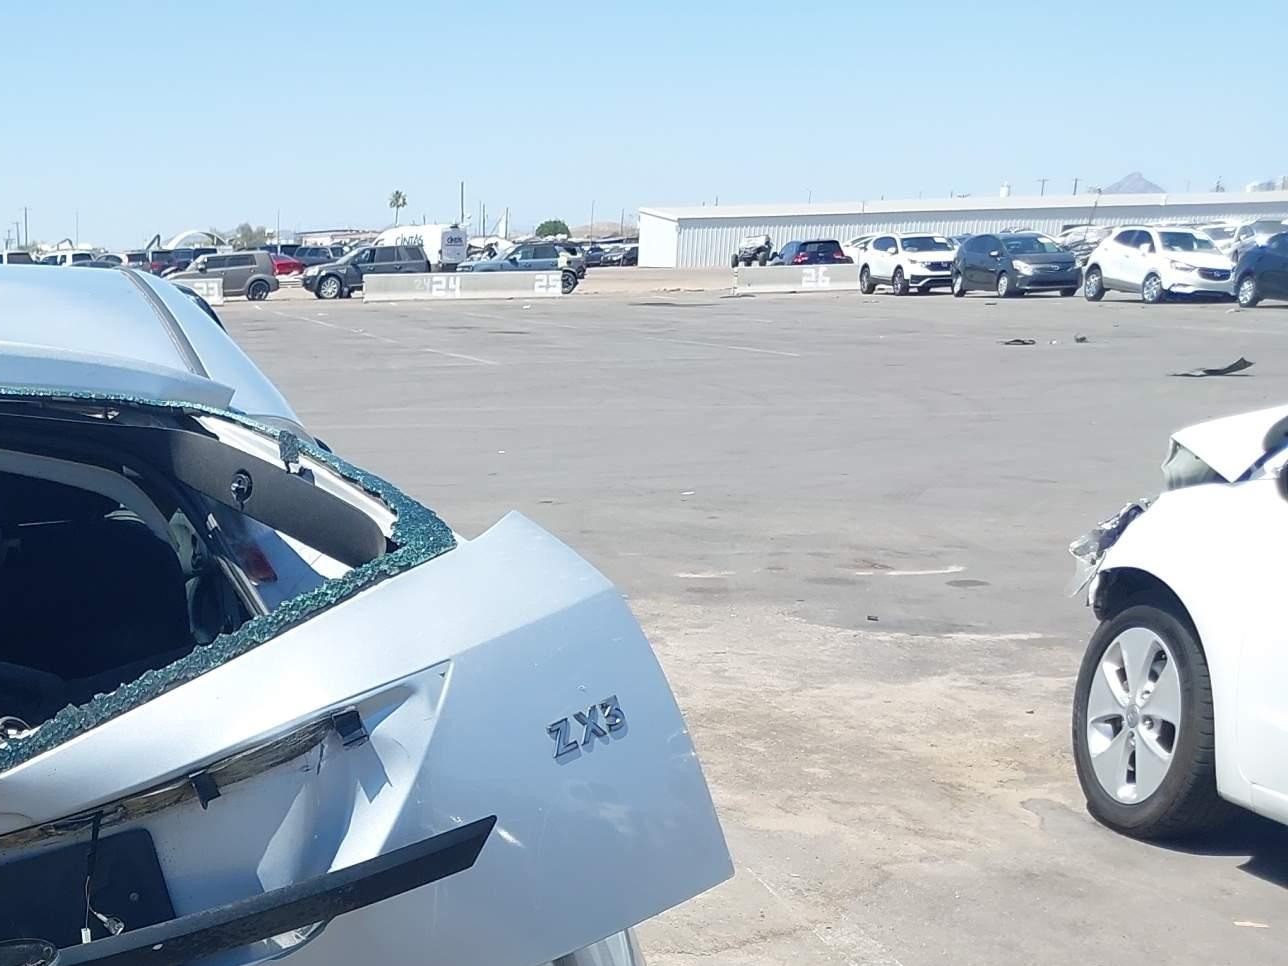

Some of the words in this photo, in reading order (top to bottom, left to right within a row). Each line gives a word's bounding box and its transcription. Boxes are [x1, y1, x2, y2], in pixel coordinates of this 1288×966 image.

[432, 276, 460, 296] 24
[534, 274, 560, 294] 25
[801, 266, 830, 288] 26
[546, 696, 626, 758] ZX3
